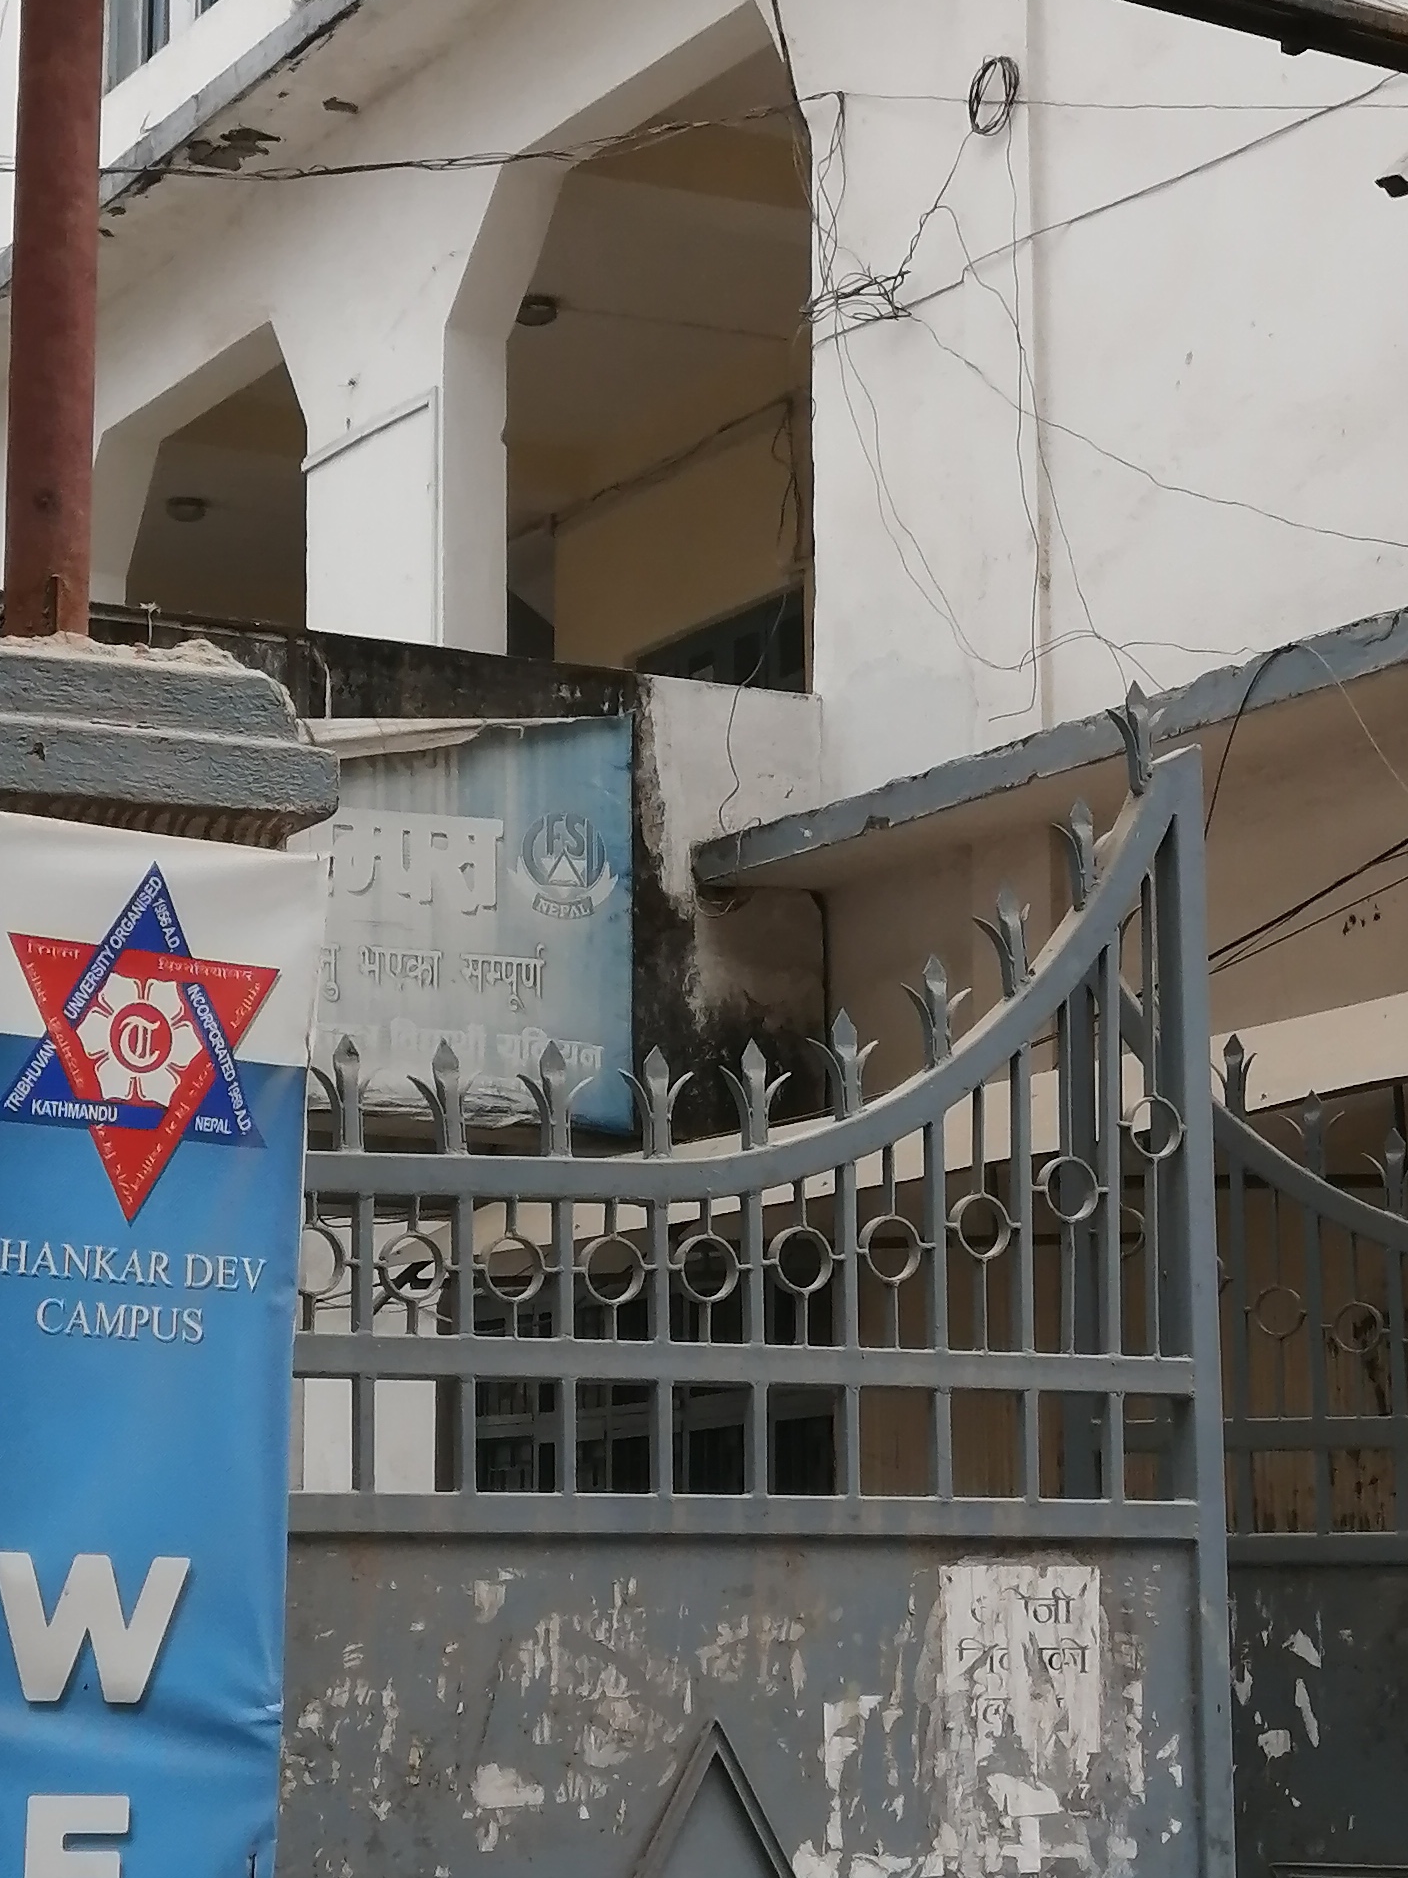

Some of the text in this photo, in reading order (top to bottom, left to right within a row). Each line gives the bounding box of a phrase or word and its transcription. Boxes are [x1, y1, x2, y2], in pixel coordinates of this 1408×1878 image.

[2, 1037, 57, 1113] TRIBHUVAN
[62, 943, 116, 1021] UNIVERSITY
[108, 874, 164, 952] ORGANISED
[186, 983, 236, 1081] INCORPORATED
[30, 1097, 119, 1123] KATHMANDU
[194, 1114, 233, 1136] NEPAL
[184, 1252, 268, 1295] DEV
[35, 1296, 206, 1345] CAMPUS
